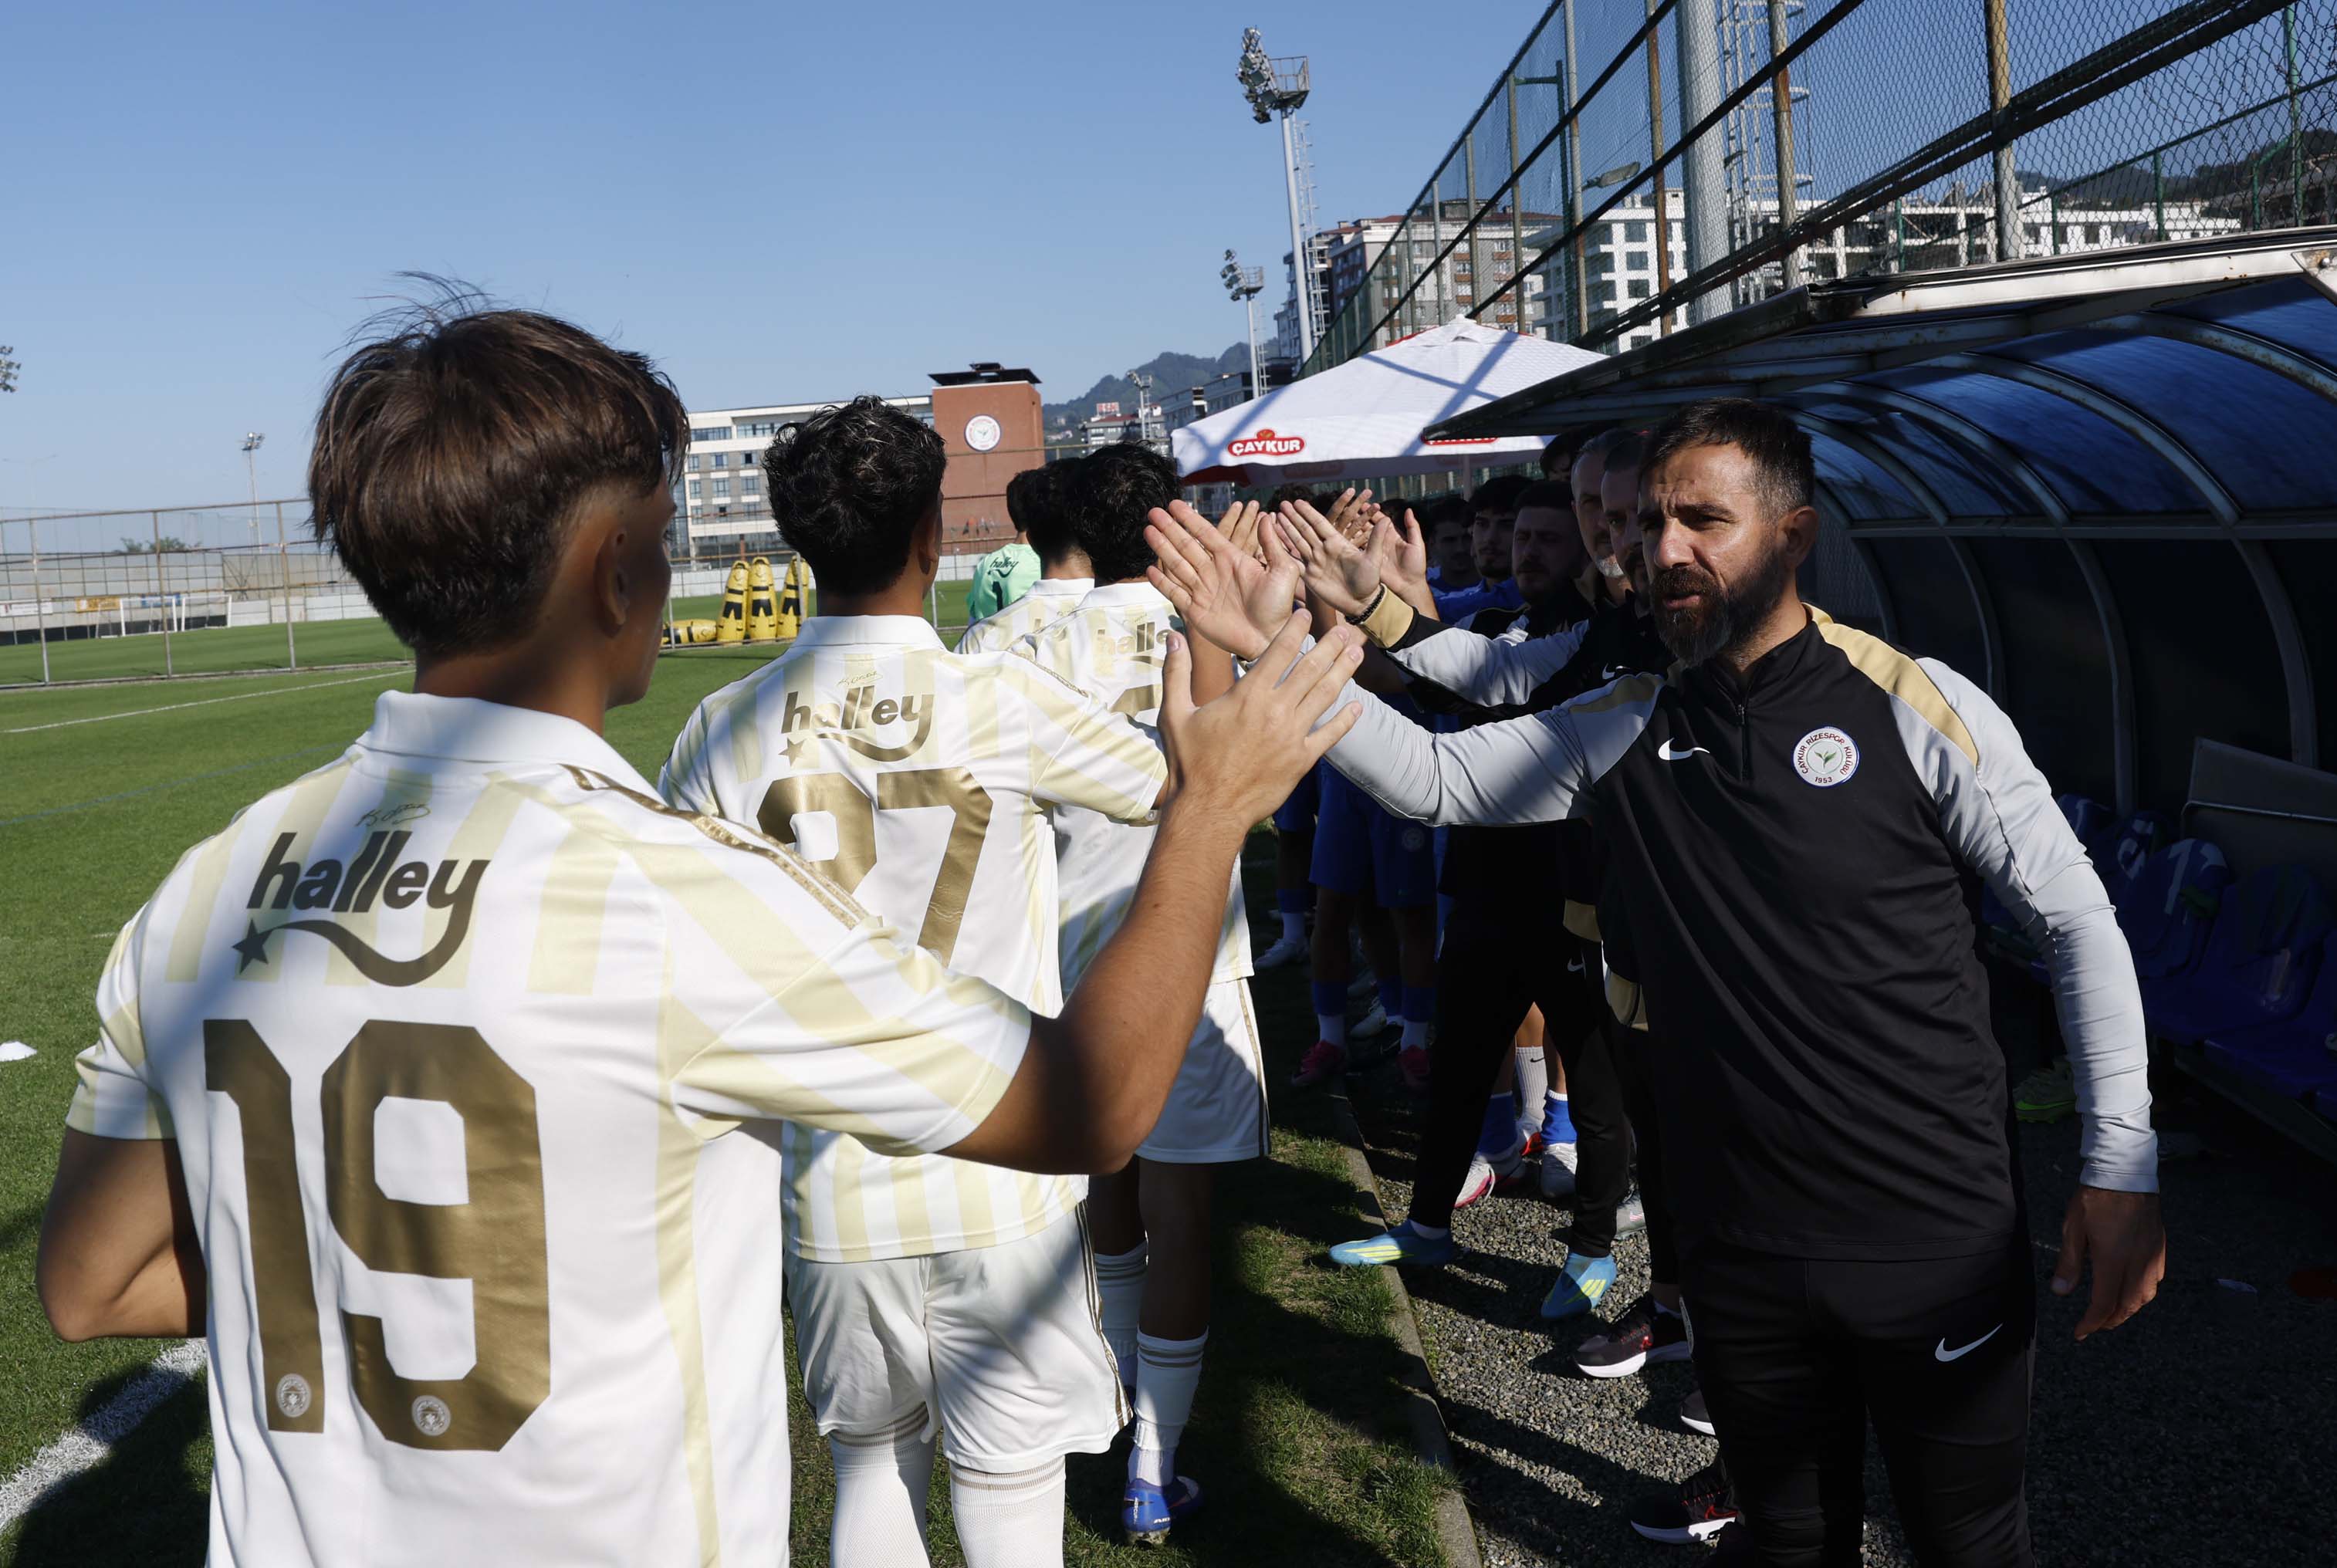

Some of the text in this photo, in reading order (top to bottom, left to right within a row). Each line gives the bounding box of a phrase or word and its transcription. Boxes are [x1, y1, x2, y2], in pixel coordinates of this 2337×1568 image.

[1232, 439, 1300, 456] ÇAYKUR
[989, 556, 1019, 578] halley
[781, 685, 934, 762] halley
[245, 830, 491, 987] halley
[203, 1019, 551, 1452] 19
